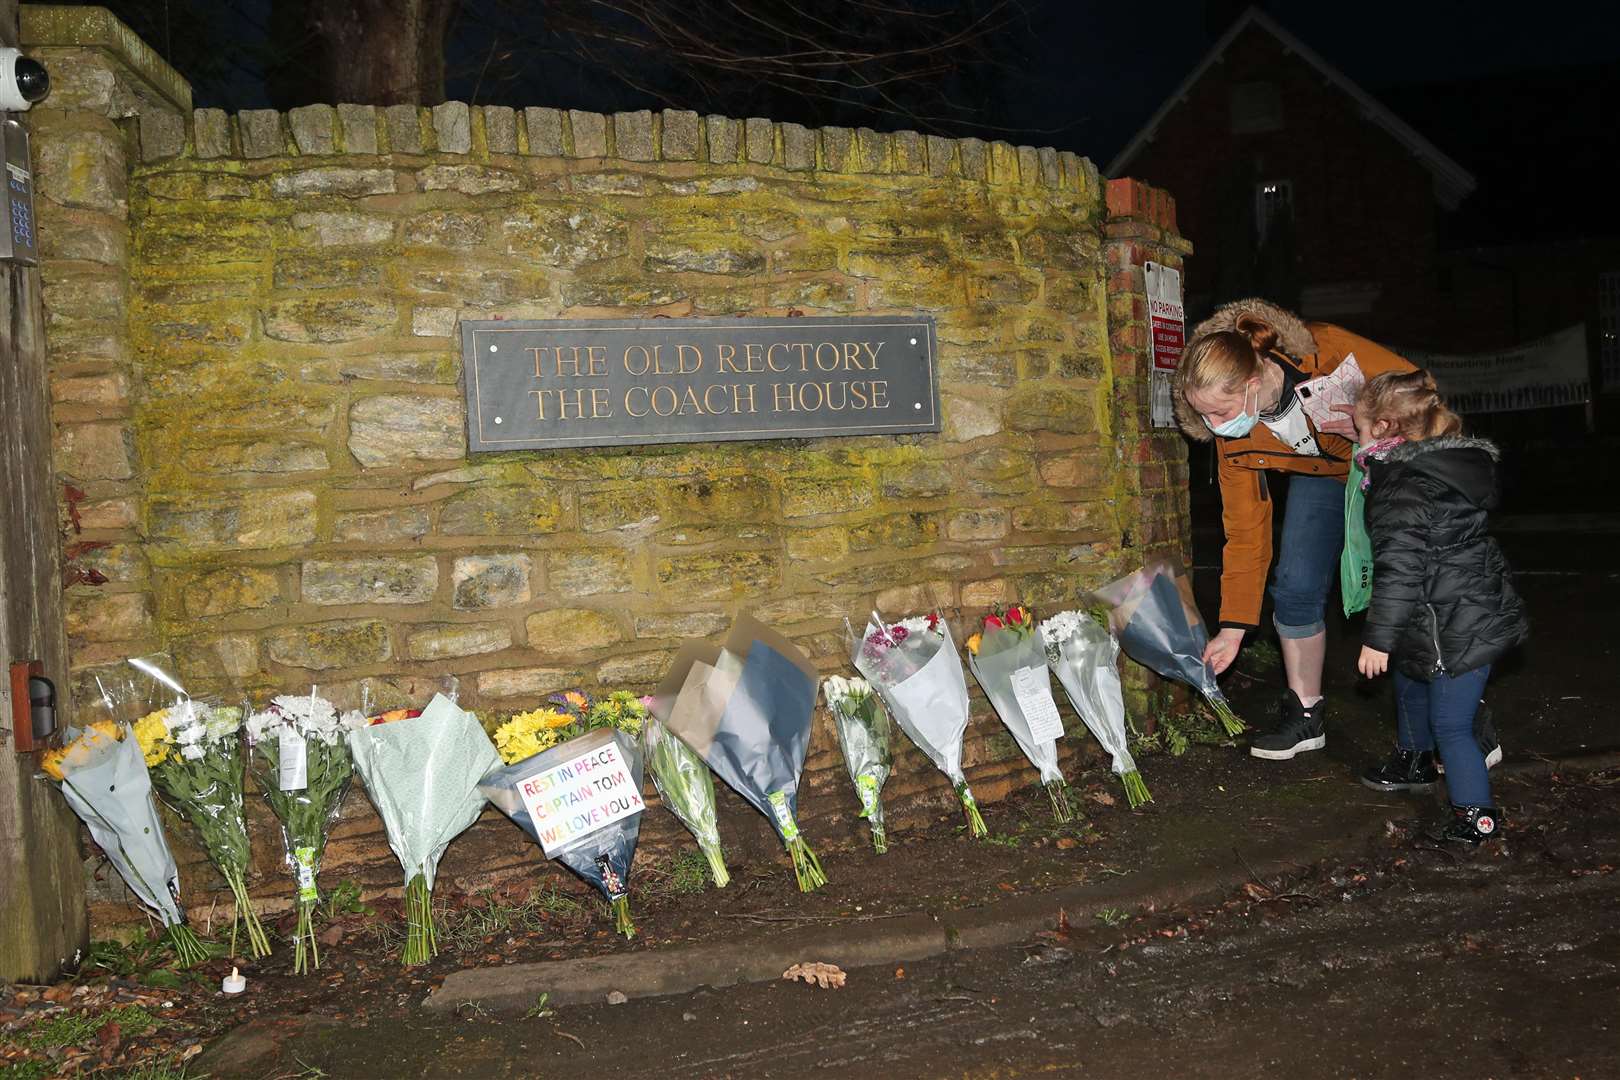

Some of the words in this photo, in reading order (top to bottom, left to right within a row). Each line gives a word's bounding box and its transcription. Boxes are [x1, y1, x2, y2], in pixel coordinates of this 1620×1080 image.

[1151, 300, 1158, 313] NO
[1159, 302, 1183, 318] PARKING
[524, 345, 609, 378] THE
[623, 344, 702, 376] OLD
[717, 341, 886, 374] RECTORY
[1426, 356, 1491, 370] Recruiting
[1495, 353, 1526, 366] Now
[528, 388, 613, 421] THE
[624, 383, 760, 418] COACH
[773, 380, 891, 412] HOUSE
[523, 772, 557, 798] REST
[558, 766, 574, 783] IN
[574, 748, 616, 776] PEACE
[535, 785, 593, 820] CAPTAIN
[593, 770, 626, 793] TOM
[540, 824, 566, 845] WE
[565, 808, 601, 834] LOVE
[601, 796, 630, 818] YOU
